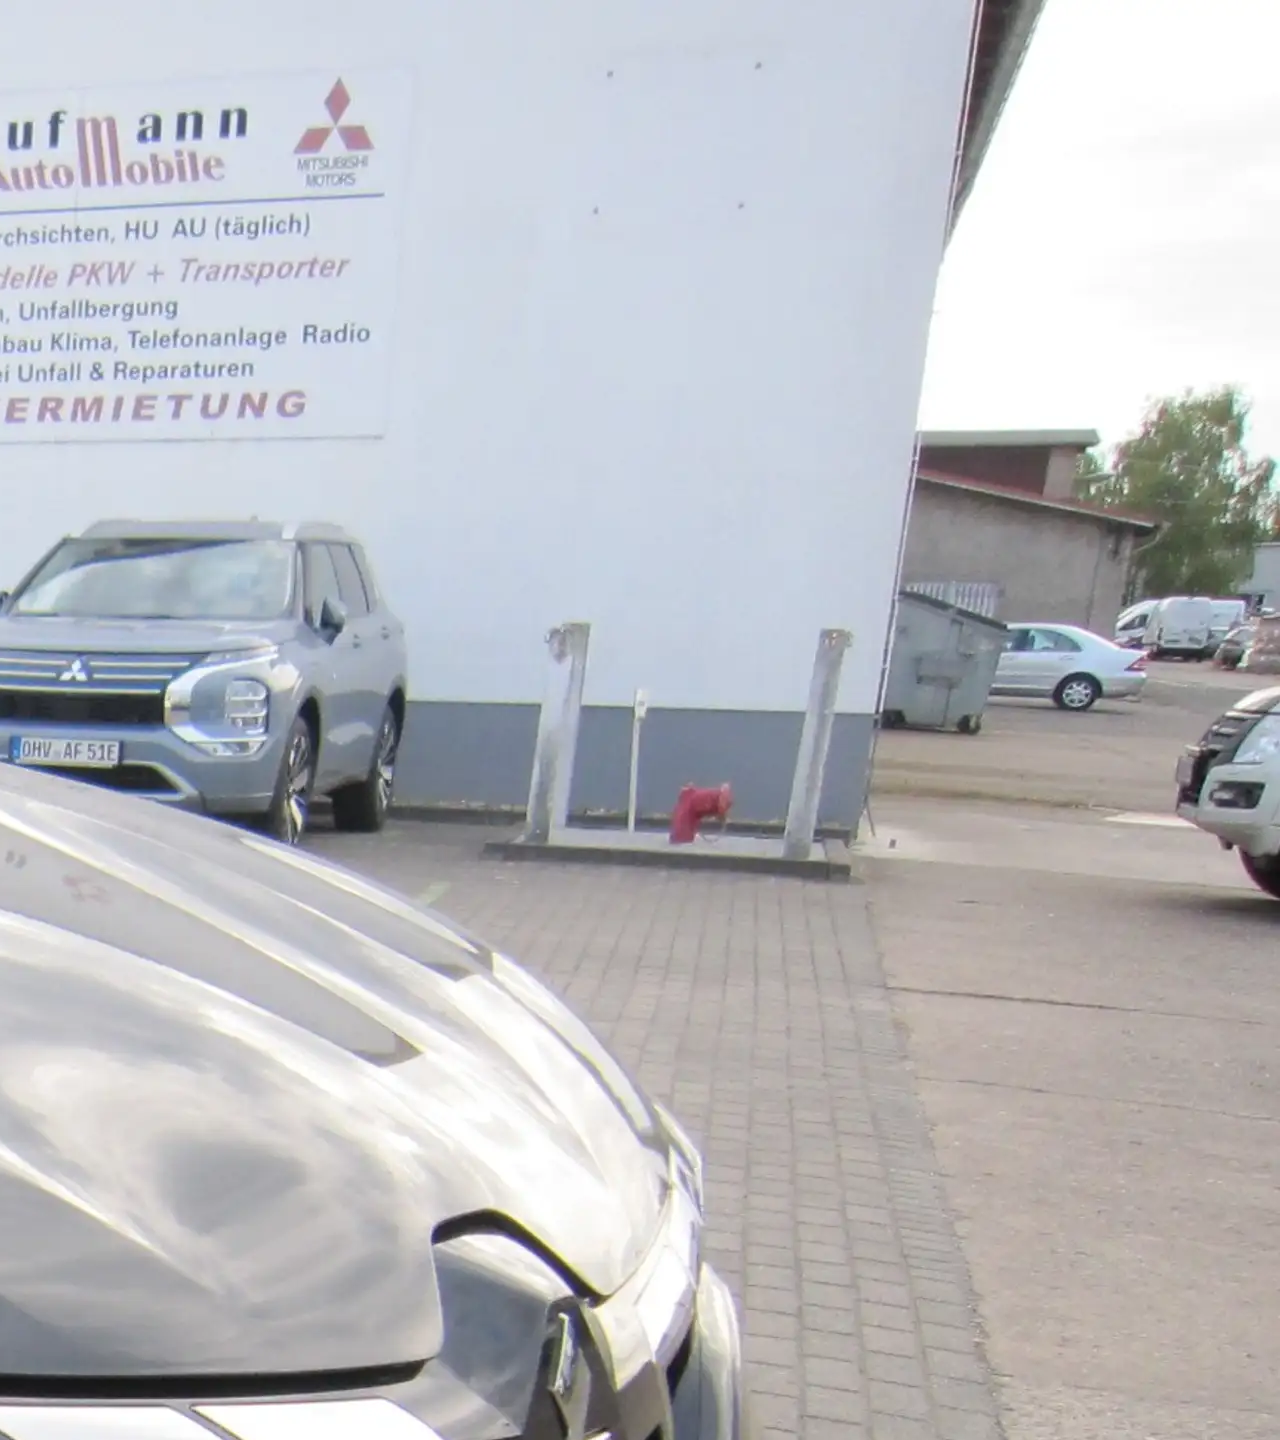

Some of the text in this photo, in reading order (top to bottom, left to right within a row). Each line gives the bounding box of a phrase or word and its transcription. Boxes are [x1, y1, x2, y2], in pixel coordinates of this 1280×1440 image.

[297, 155, 368, 171] MITSUBISHI
[305, 173, 356, 187] MOTORS
[125, 219, 158, 240] HU
[172, 217, 207, 239] AU
[215, 211, 311, 241] (täglich)
[67, 261, 135, 287] PKW
[147, 265, 165, 283] +
[180, 255, 351, 287] Transporter
[19, 299, 178, 322] Unfallbergung
[50, 331, 118, 353] Klima,
[128, 326, 287, 350] Telefonanlage
[302, 322, 371, 345] Radio
[17, 361, 81, 383] Unfall
[89, 361, 105, 381] &
[113, 359, 254, 384] Reparaturen
[22, 740, 117, 762] OHV AF 51E
